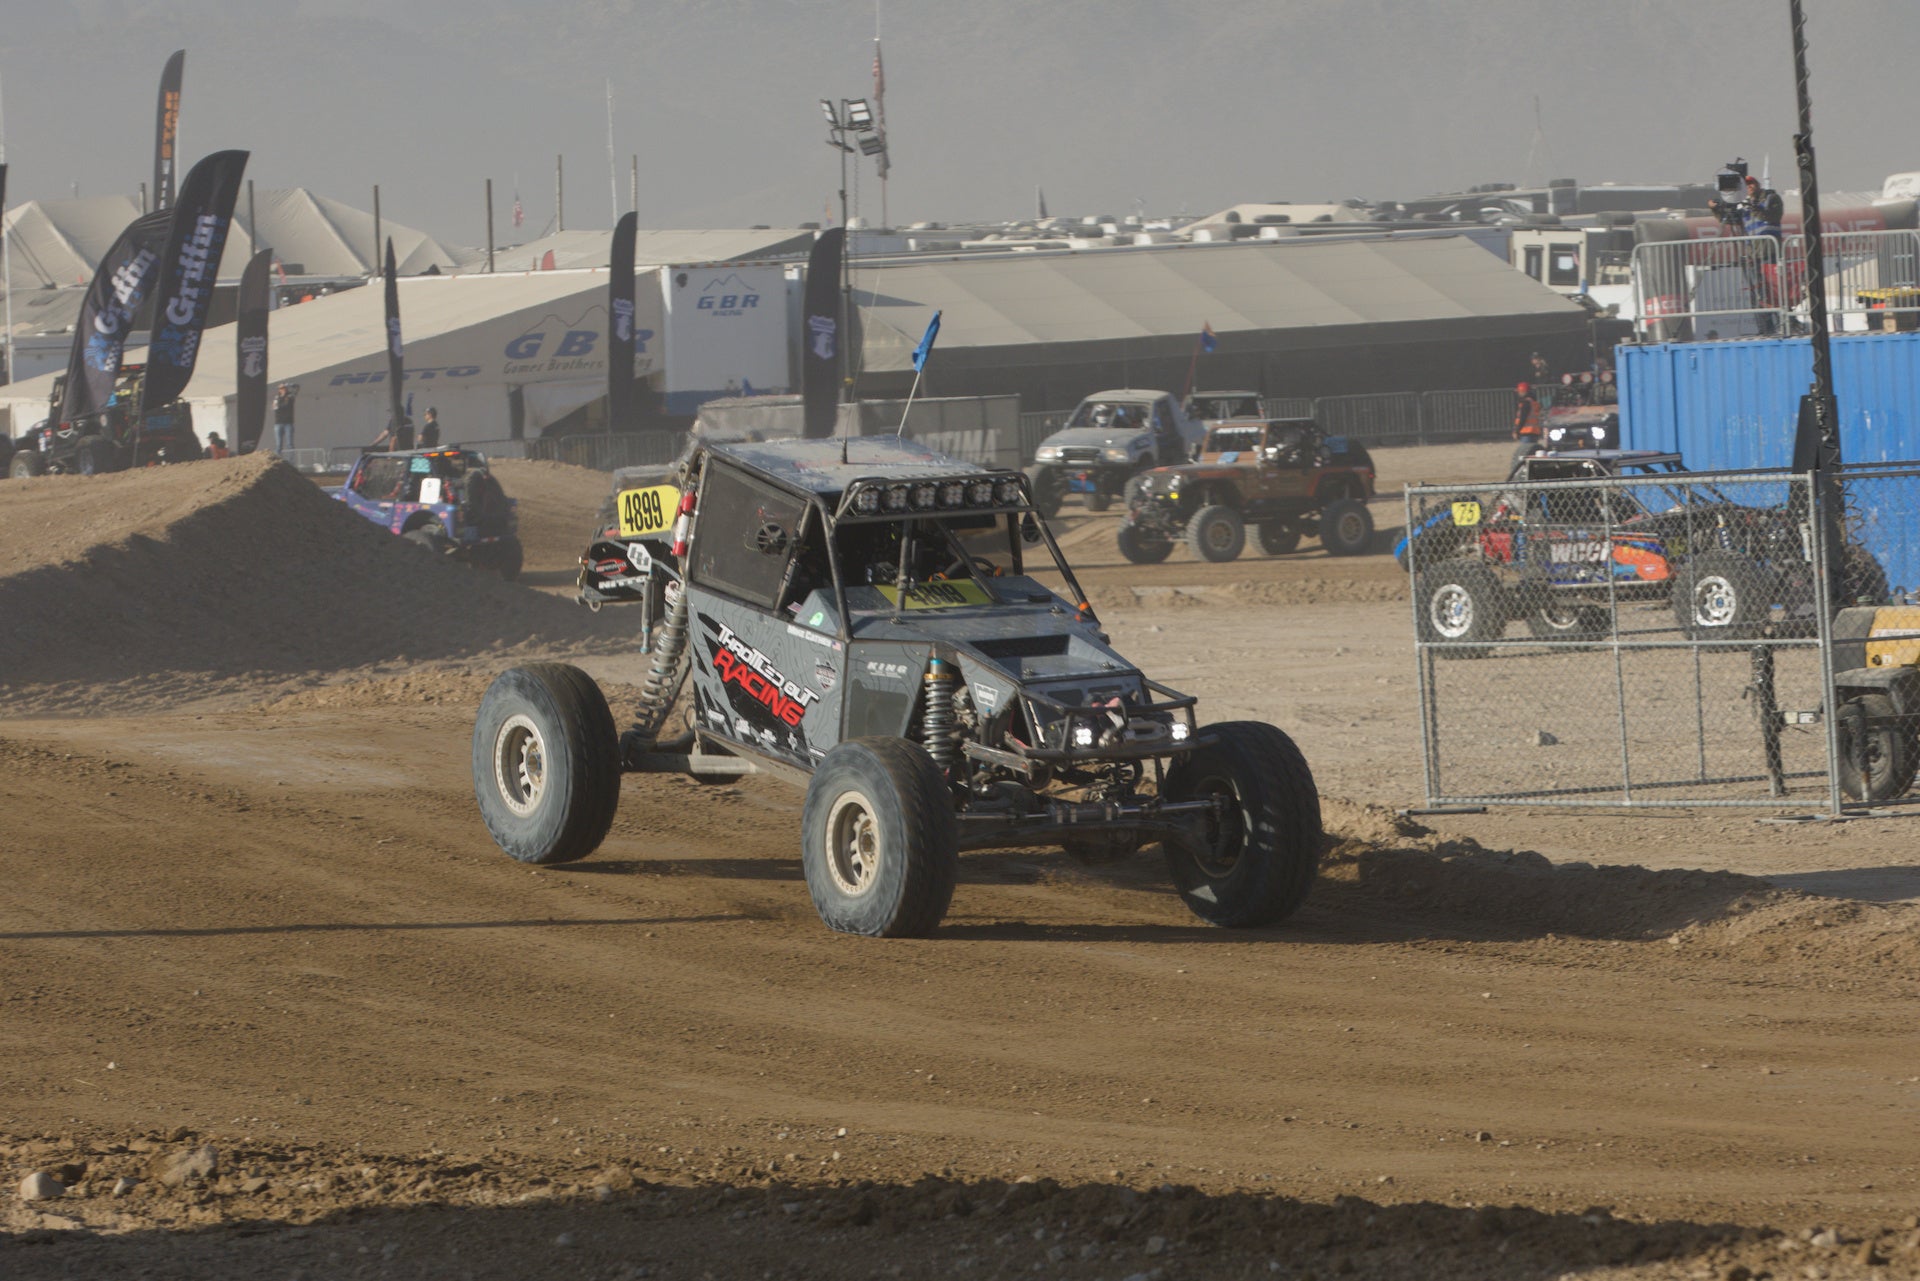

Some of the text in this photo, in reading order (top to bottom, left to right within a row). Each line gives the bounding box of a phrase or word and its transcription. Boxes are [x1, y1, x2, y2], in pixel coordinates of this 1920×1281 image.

[166, 214, 218, 326] Griffin
[696, 294, 760, 310] GBR
[624, 490, 664, 533] 4899
[1457, 502, 1476, 522] 75
[598, 575, 648, 590] NITTO
[908, 583, 967, 606] 4899
[866, 661, 908, 675] KING
[713, 647, 805, 727] RACING
[783, 683, 820, 708] OUT
